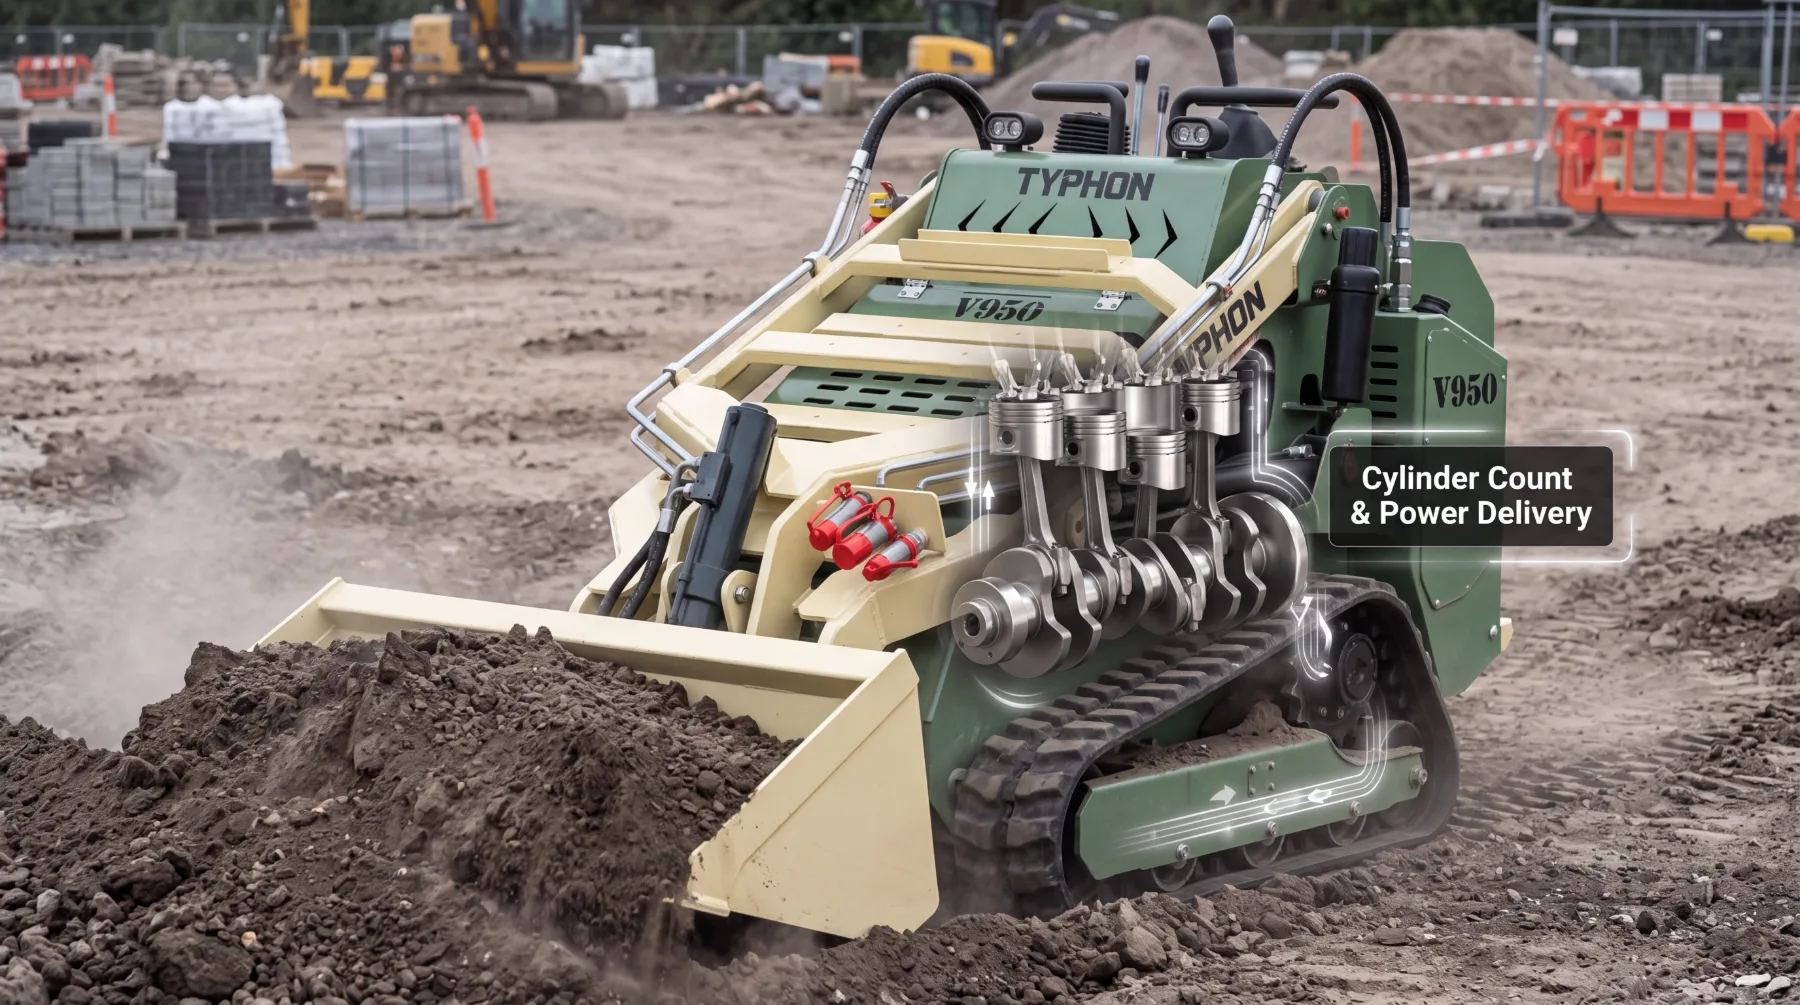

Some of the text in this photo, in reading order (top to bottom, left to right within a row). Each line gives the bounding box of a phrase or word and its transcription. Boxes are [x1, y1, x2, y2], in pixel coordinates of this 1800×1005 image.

[1018, 167, 1155, 201] TYPHON
[955, 297, 1045, 322] V950
[1187, 280, 1266, 371] PHON
[1433, 373, 1498, 408] V950
